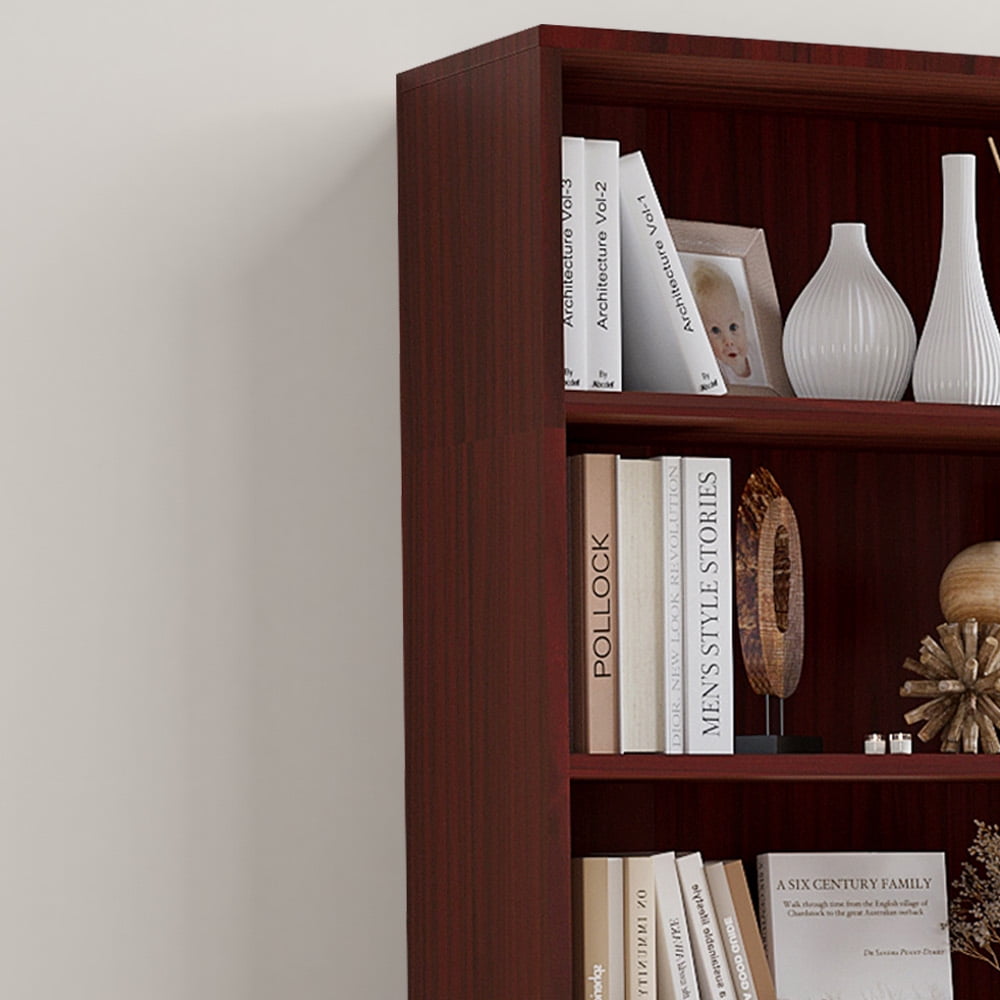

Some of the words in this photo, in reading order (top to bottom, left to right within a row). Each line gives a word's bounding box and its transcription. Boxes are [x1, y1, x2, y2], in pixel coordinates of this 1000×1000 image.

[562, 178, 572, 222] Vol-3
[595, 181, 607, 225] Vol-2
[637, 195, 657, 236] Vol-1
[562, 228, 574, 328] Architecture
[596, 231, 608, 330] Architecture
[655, 240, 694, 333] Architecture
[667, 465, 680, 586] REVOLUTION
[698, 471, 719, 574] STORIES
[591, 533, 612, 679] POLLOCK
[669, 592, 681, 644] LOOK
[700, 580, 720, 656] STYLE
[669, 649, 681, 691] NEW
[701, 663, 721, 736] MEN'S
[776, 879, 786, 891] A
[788, 878, 810, 890] SIX
[812, 878, 878, 891] CENTURY
[881, 877, 933, 890] FAMILY
